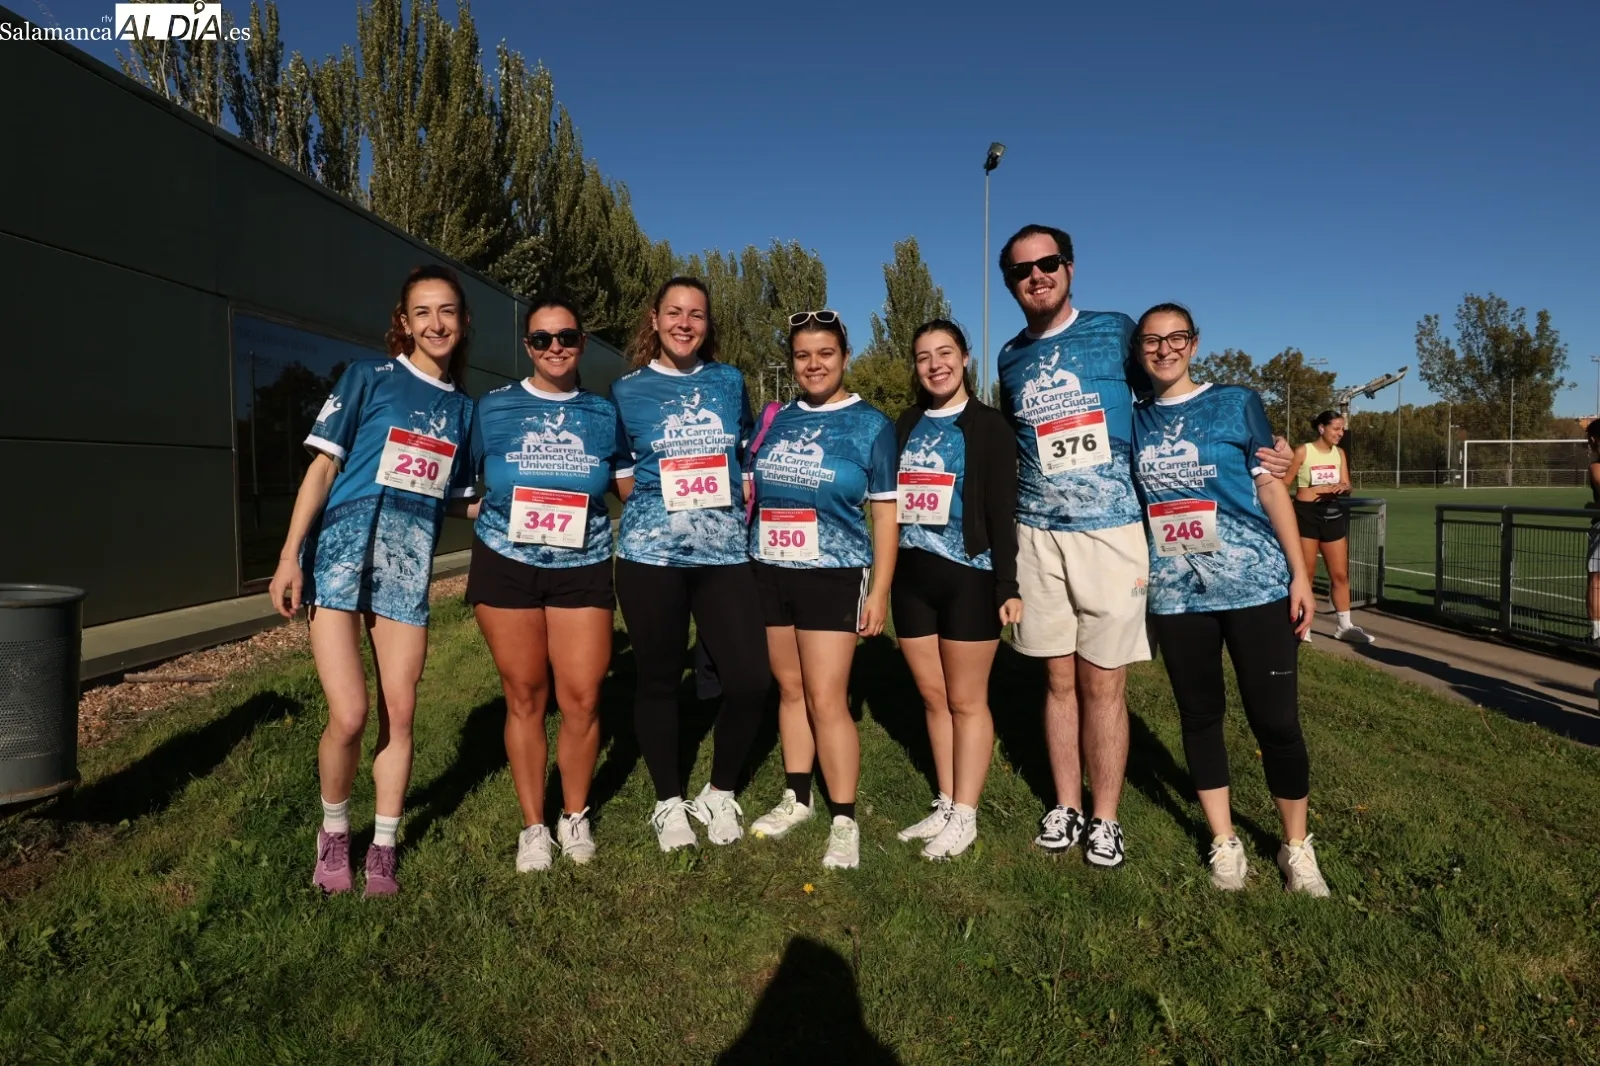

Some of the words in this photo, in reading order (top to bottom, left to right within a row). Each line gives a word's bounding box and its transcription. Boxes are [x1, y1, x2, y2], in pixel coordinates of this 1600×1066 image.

[1025, 395, 1040, 409] IX
[1041, 389, 1080, 403] Carrera
[1061, 394, 1099, 408] Ciudad
[668, 429, 684, 439] IX
[685, 427, 723, 437] Carrera
[526, 445, 543, 453] IX
[544, 445, 584, 455] Carrera
[652, 437, 704, 452] Salamanca
[704, 434, 736, 445] Ciudad
[1051, 433, 1098, 459] 376
[507, 453, 564, 461] Salamanca
[565, 454, 600, 465] Ciudad
[665, 445, 726, 458] Universitaria
[395, 454, 440, 481] 230
[520, 461, 590, 472] Universitaria
[770, 452, 784, 463] IX
[784, 455, 820, 468] Carrera
[1142, 462, 1156, 473] IX
[1158, 460, 1198, 471] Carrera
[763, 470, 818, 487] Universitaria
[799, 466, 835, 481] Ciudad
[1178, 467, 1216, 479] Ciudad
[1317, 472, 1335, 480] 244
[675, 475, 718, 497] 346
[905, 492, 939, 511] 349
[524, 511, 573, 533] 347
[767, 529, 806, 548] 350
[1162, 520, 1204, 543] 246
